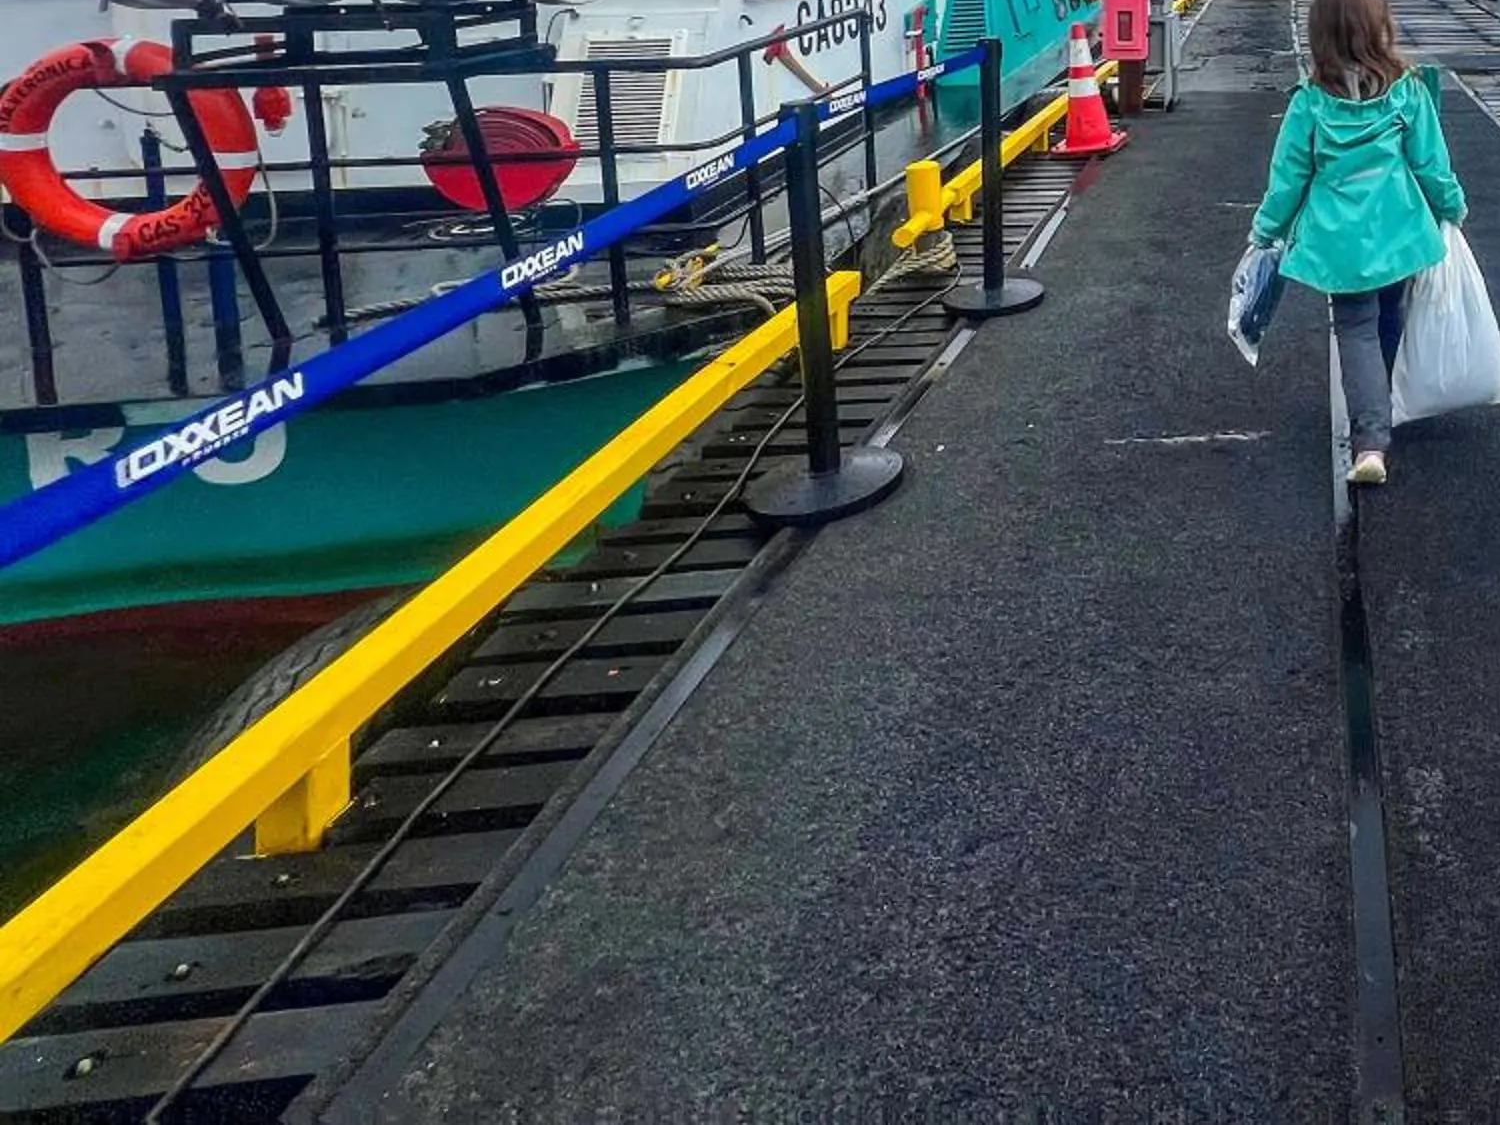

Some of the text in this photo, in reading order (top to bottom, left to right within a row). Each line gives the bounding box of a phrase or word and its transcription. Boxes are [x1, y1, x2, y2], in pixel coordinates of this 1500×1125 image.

[686, 152, 736, 190] OXXEAN
[501, 231, 584, 290] OXXEAN
[115, 371, 305, 488] OXXEAN
